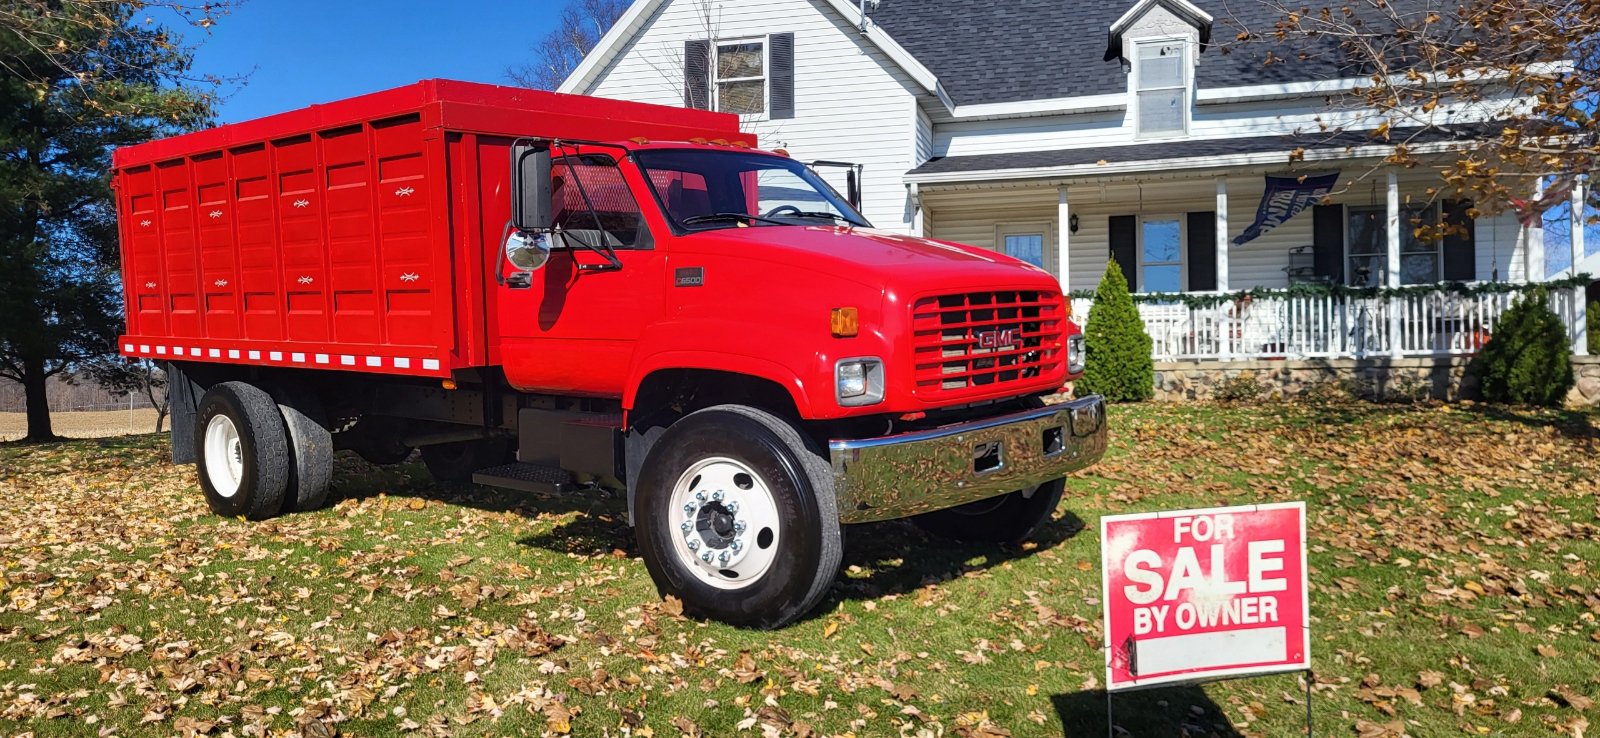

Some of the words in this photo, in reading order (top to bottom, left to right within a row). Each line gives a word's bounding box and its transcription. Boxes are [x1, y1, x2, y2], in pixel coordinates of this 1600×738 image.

[979, 327, 1022, 349] GMC
[1174, 514, 1235, 543] FOR
[1123, 539, 1287, 604] SALE
[1134, 605, 1169, 635] BY
[1175, 596, 1278, 630] OWNER
